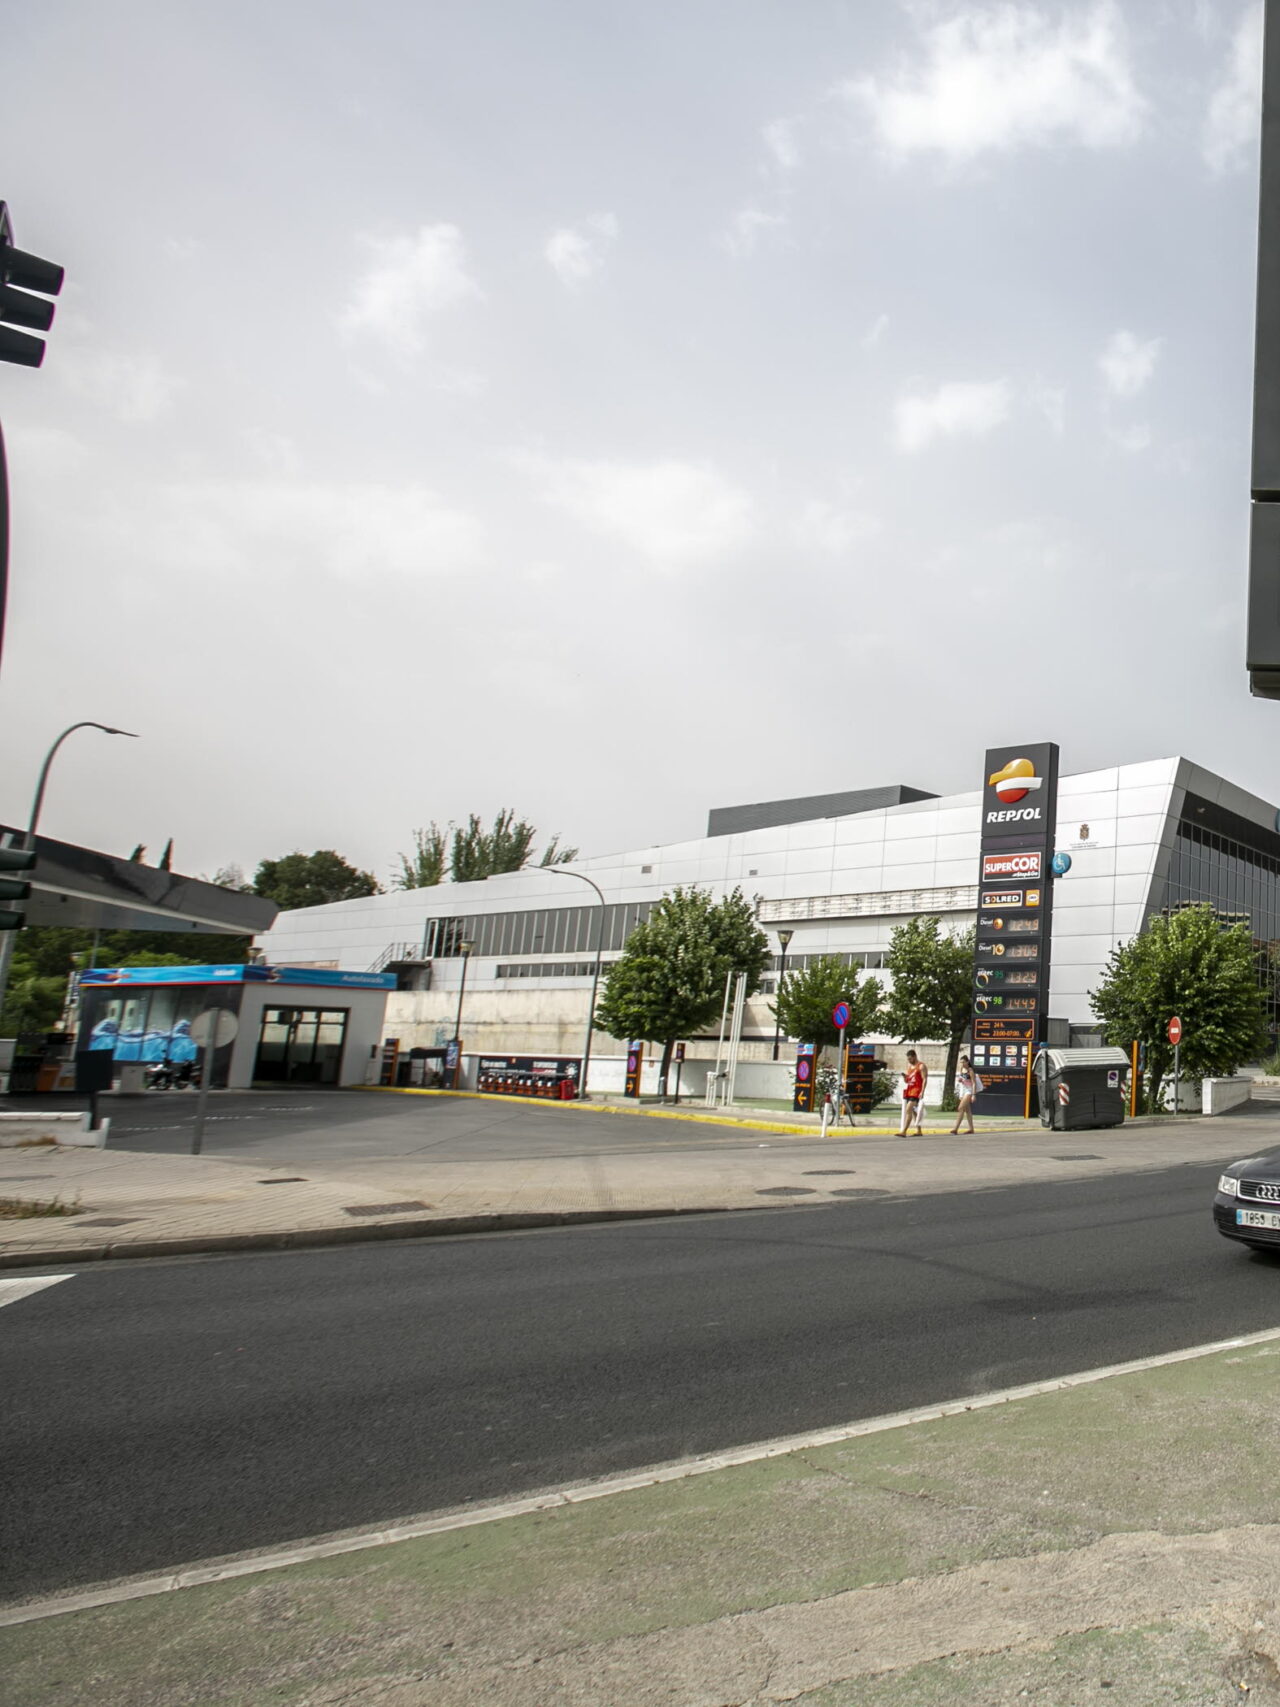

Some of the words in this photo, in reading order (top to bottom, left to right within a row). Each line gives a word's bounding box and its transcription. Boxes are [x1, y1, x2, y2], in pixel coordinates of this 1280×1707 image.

[987, 807, 1042, 824] REPSOL
[985, 856, 1039, 873] SUPERCOR
[985, 895, 1020, 904] SOLRED
[993, 996, 1003, 1005] 98
